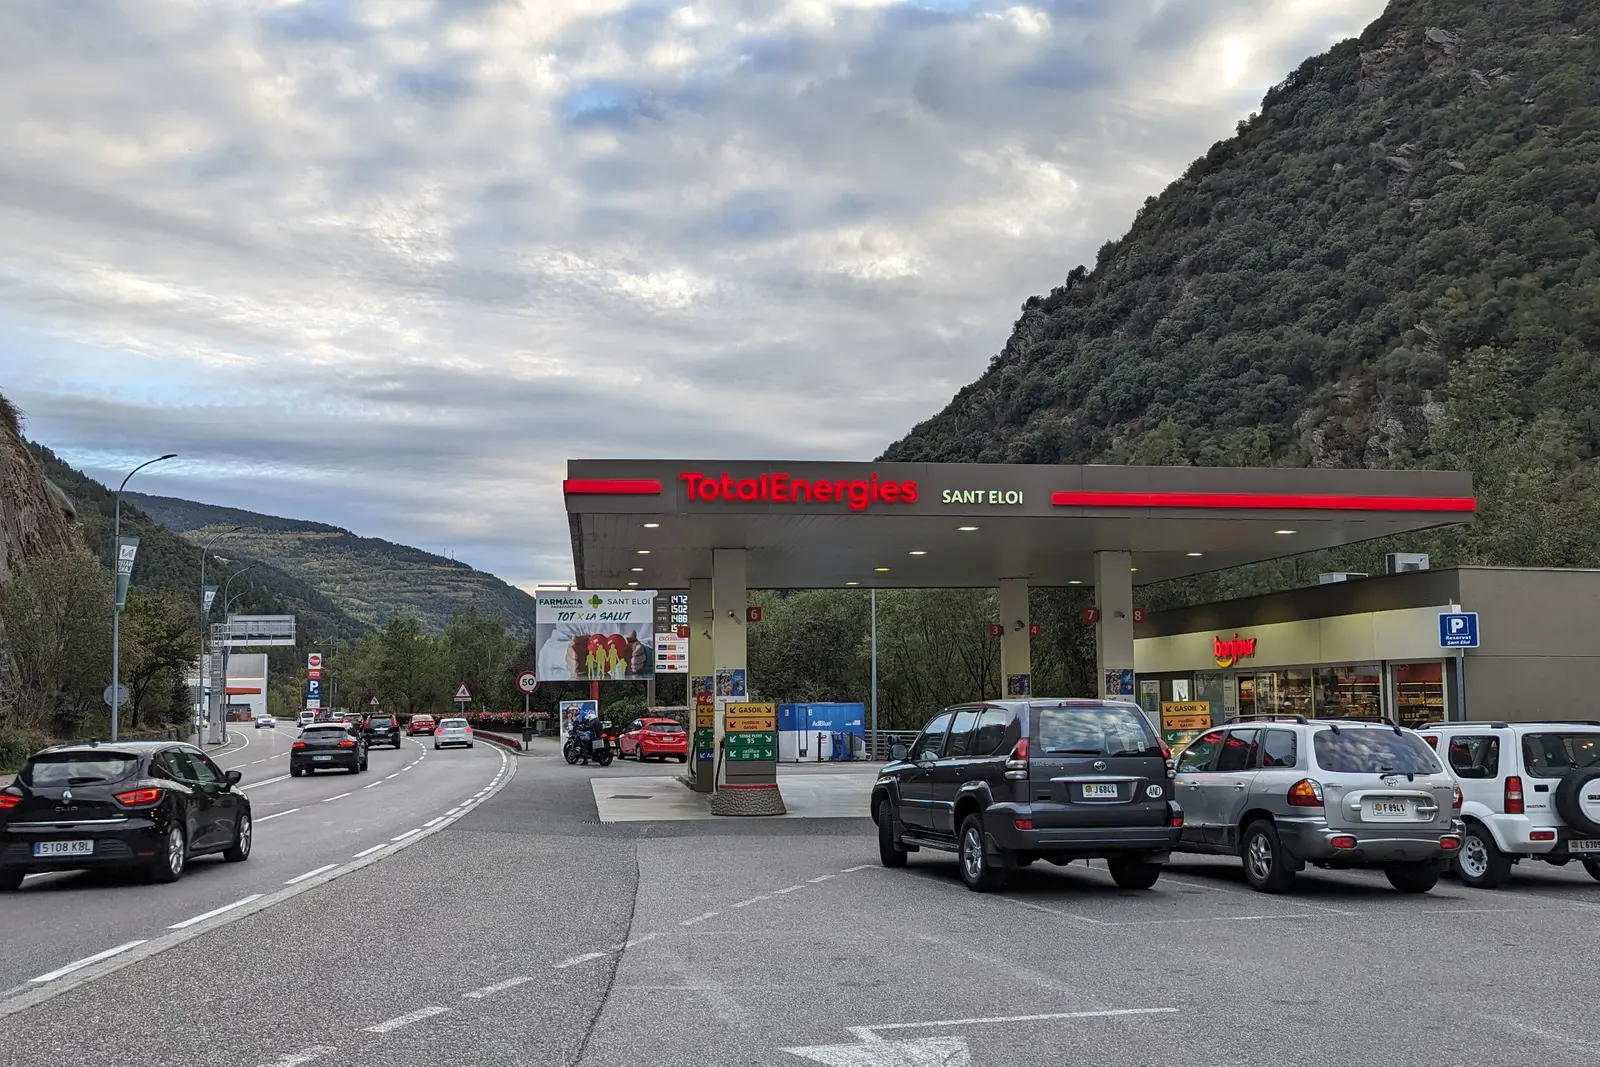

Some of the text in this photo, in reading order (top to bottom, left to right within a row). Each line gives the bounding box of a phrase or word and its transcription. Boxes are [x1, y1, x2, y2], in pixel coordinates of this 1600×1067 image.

[680, 472, 919, 511] TotalEnergies
[942, 489, 1023, 505] SANT ELOI
[539, 596, 584, 606] FARMÀCIA
[607, 598, 630, 606] SANT
[631, 598, 651, 606] ELOI
[557, 611, 577, 621] TOT
[585, 612, 597, 621] LA
[599, 611, 632, 621] SALUT
[750, 609, 758, 620] 6
[1087, 609, 1095, 620] 7
[1134, 610, 1142, 620] 8
[993, 626, 999, 634] 3
[1031, 626, 1037, 634] 4
[1451, 618, 1464, 633] P
[1214, 632, 1257, 664] bonjour
[522, 678, 534, 687] 50
[738, 706, 762, 714] GASOIL
[1149, 786, 1160, 796] AND
[42, 841, 91, 853] 5108 KBL
